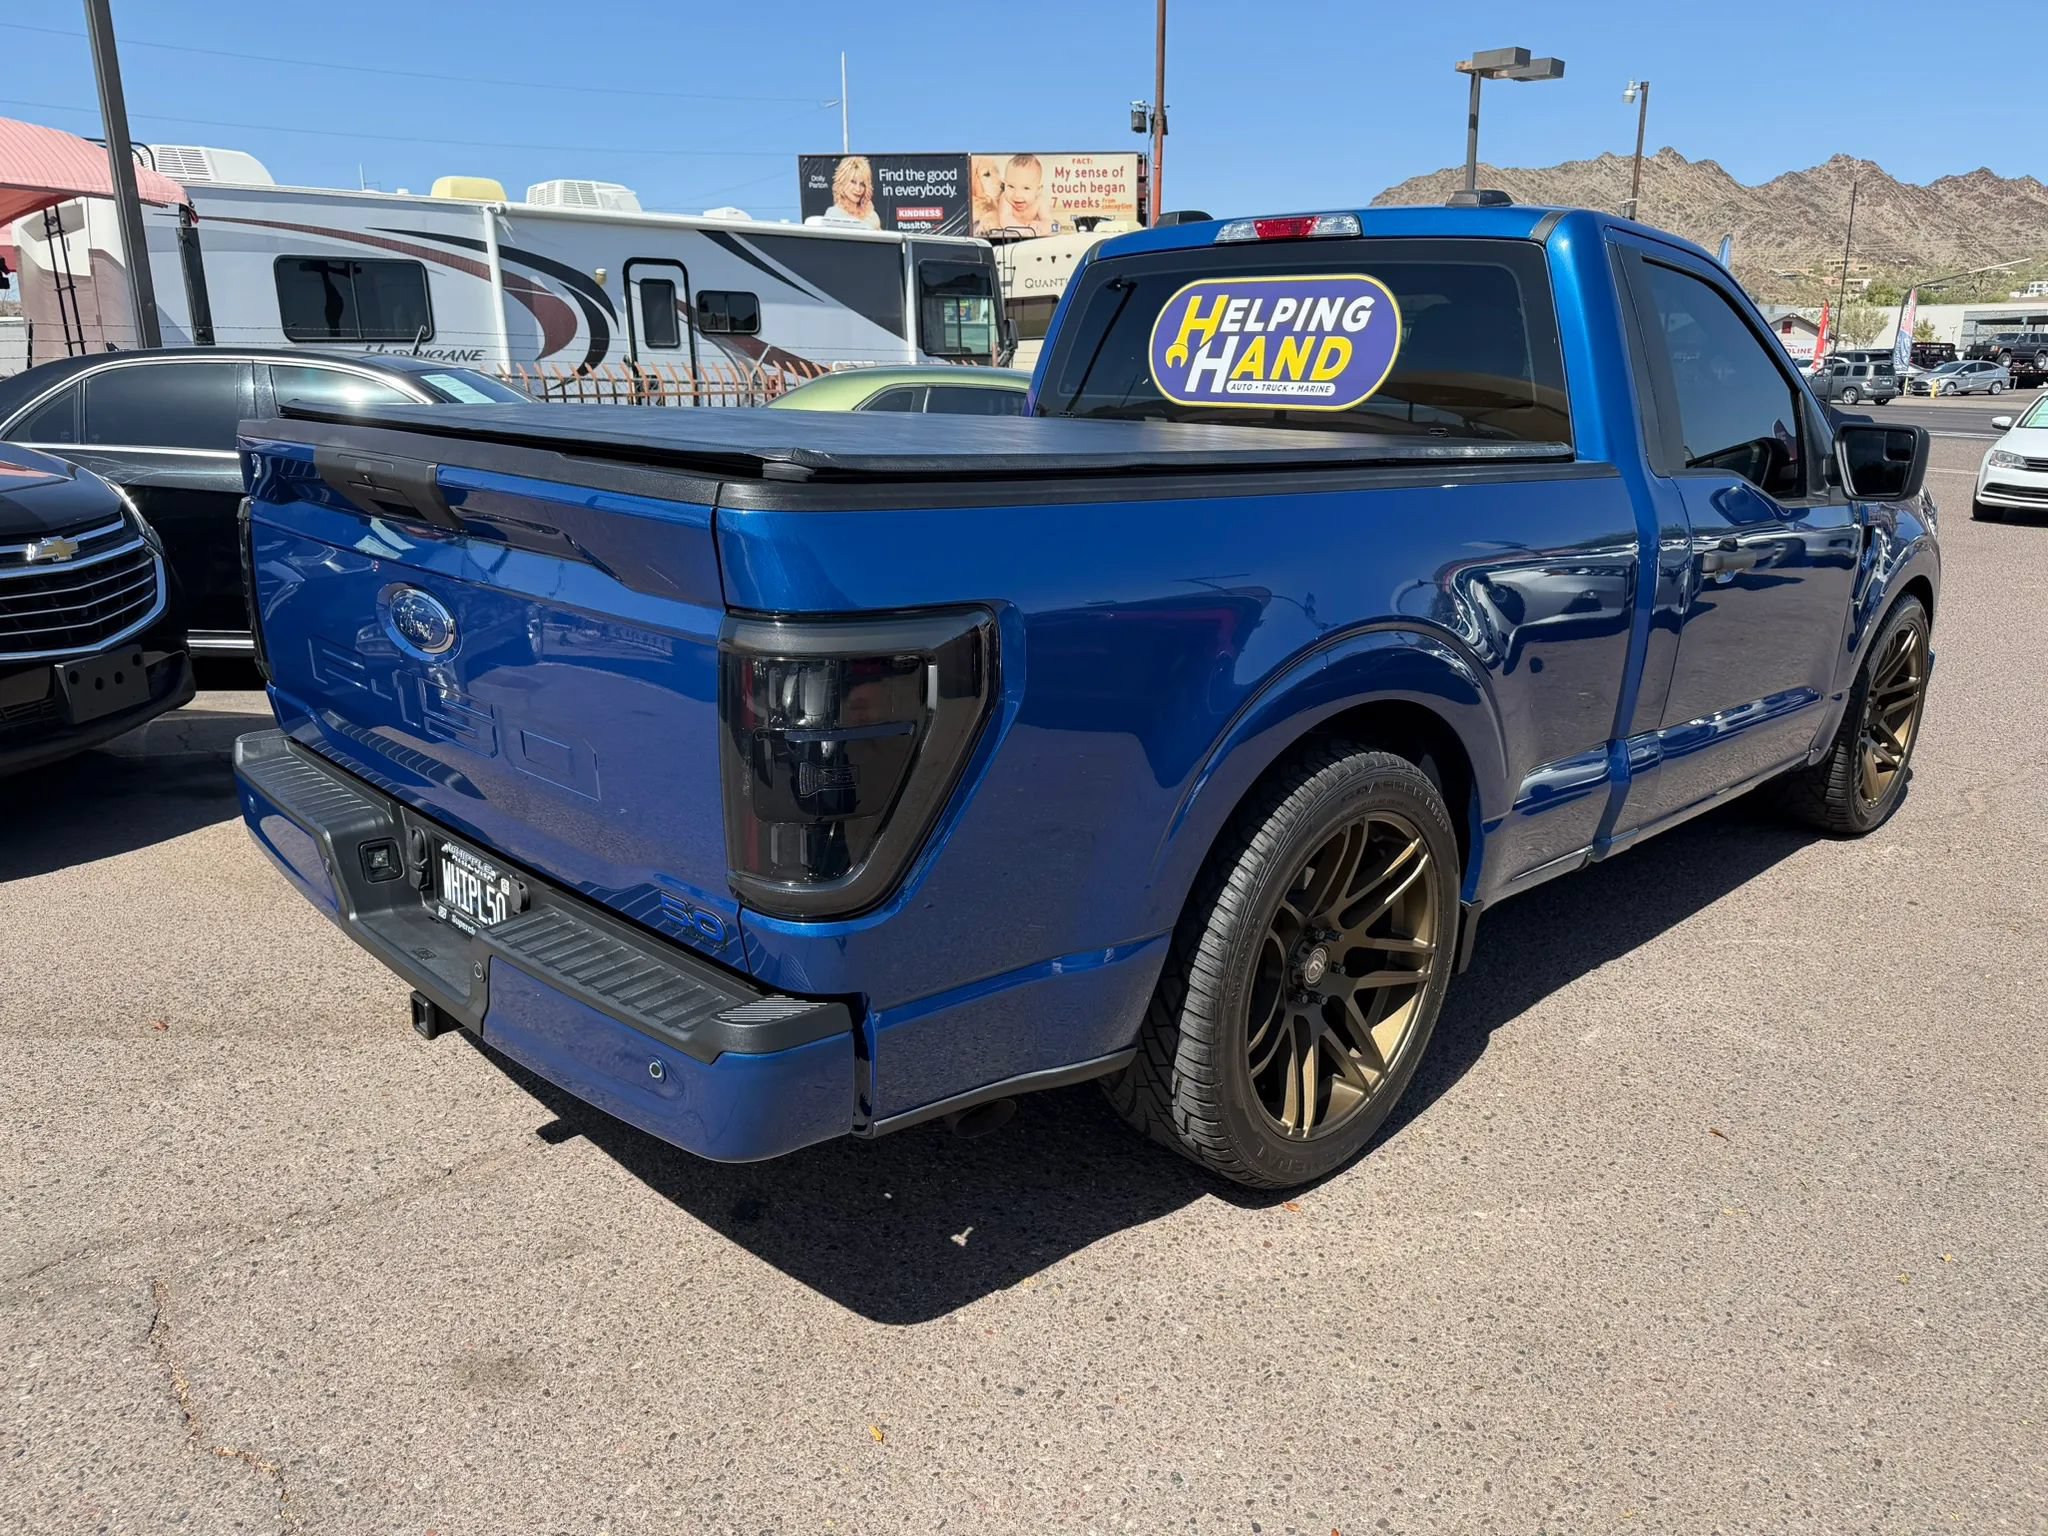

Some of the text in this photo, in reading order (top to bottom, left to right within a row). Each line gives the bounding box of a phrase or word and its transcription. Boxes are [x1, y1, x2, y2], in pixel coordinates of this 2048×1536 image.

[811, 175, 826, 183] Dolly
[879, 168, 958, 183] Find the good
[1054, 166, 1124, 181] My sense of
[808, 181, 828, 189] Parton
[882, 183, 958, 198] in everybody.
[1051, 181, 1126, 196] touch began
[1051, 197, 1100, 208] 7 weeks
[898, 209, 942, 218] KINDNESS
[1175, 295, 1376, 345] HELPING
[1184, 335, 1353, 393] HAND
[1230, 383, 1331, 393] AUTO TRUCK MARINE
[441, 858, 507, 925] WHIPL50
